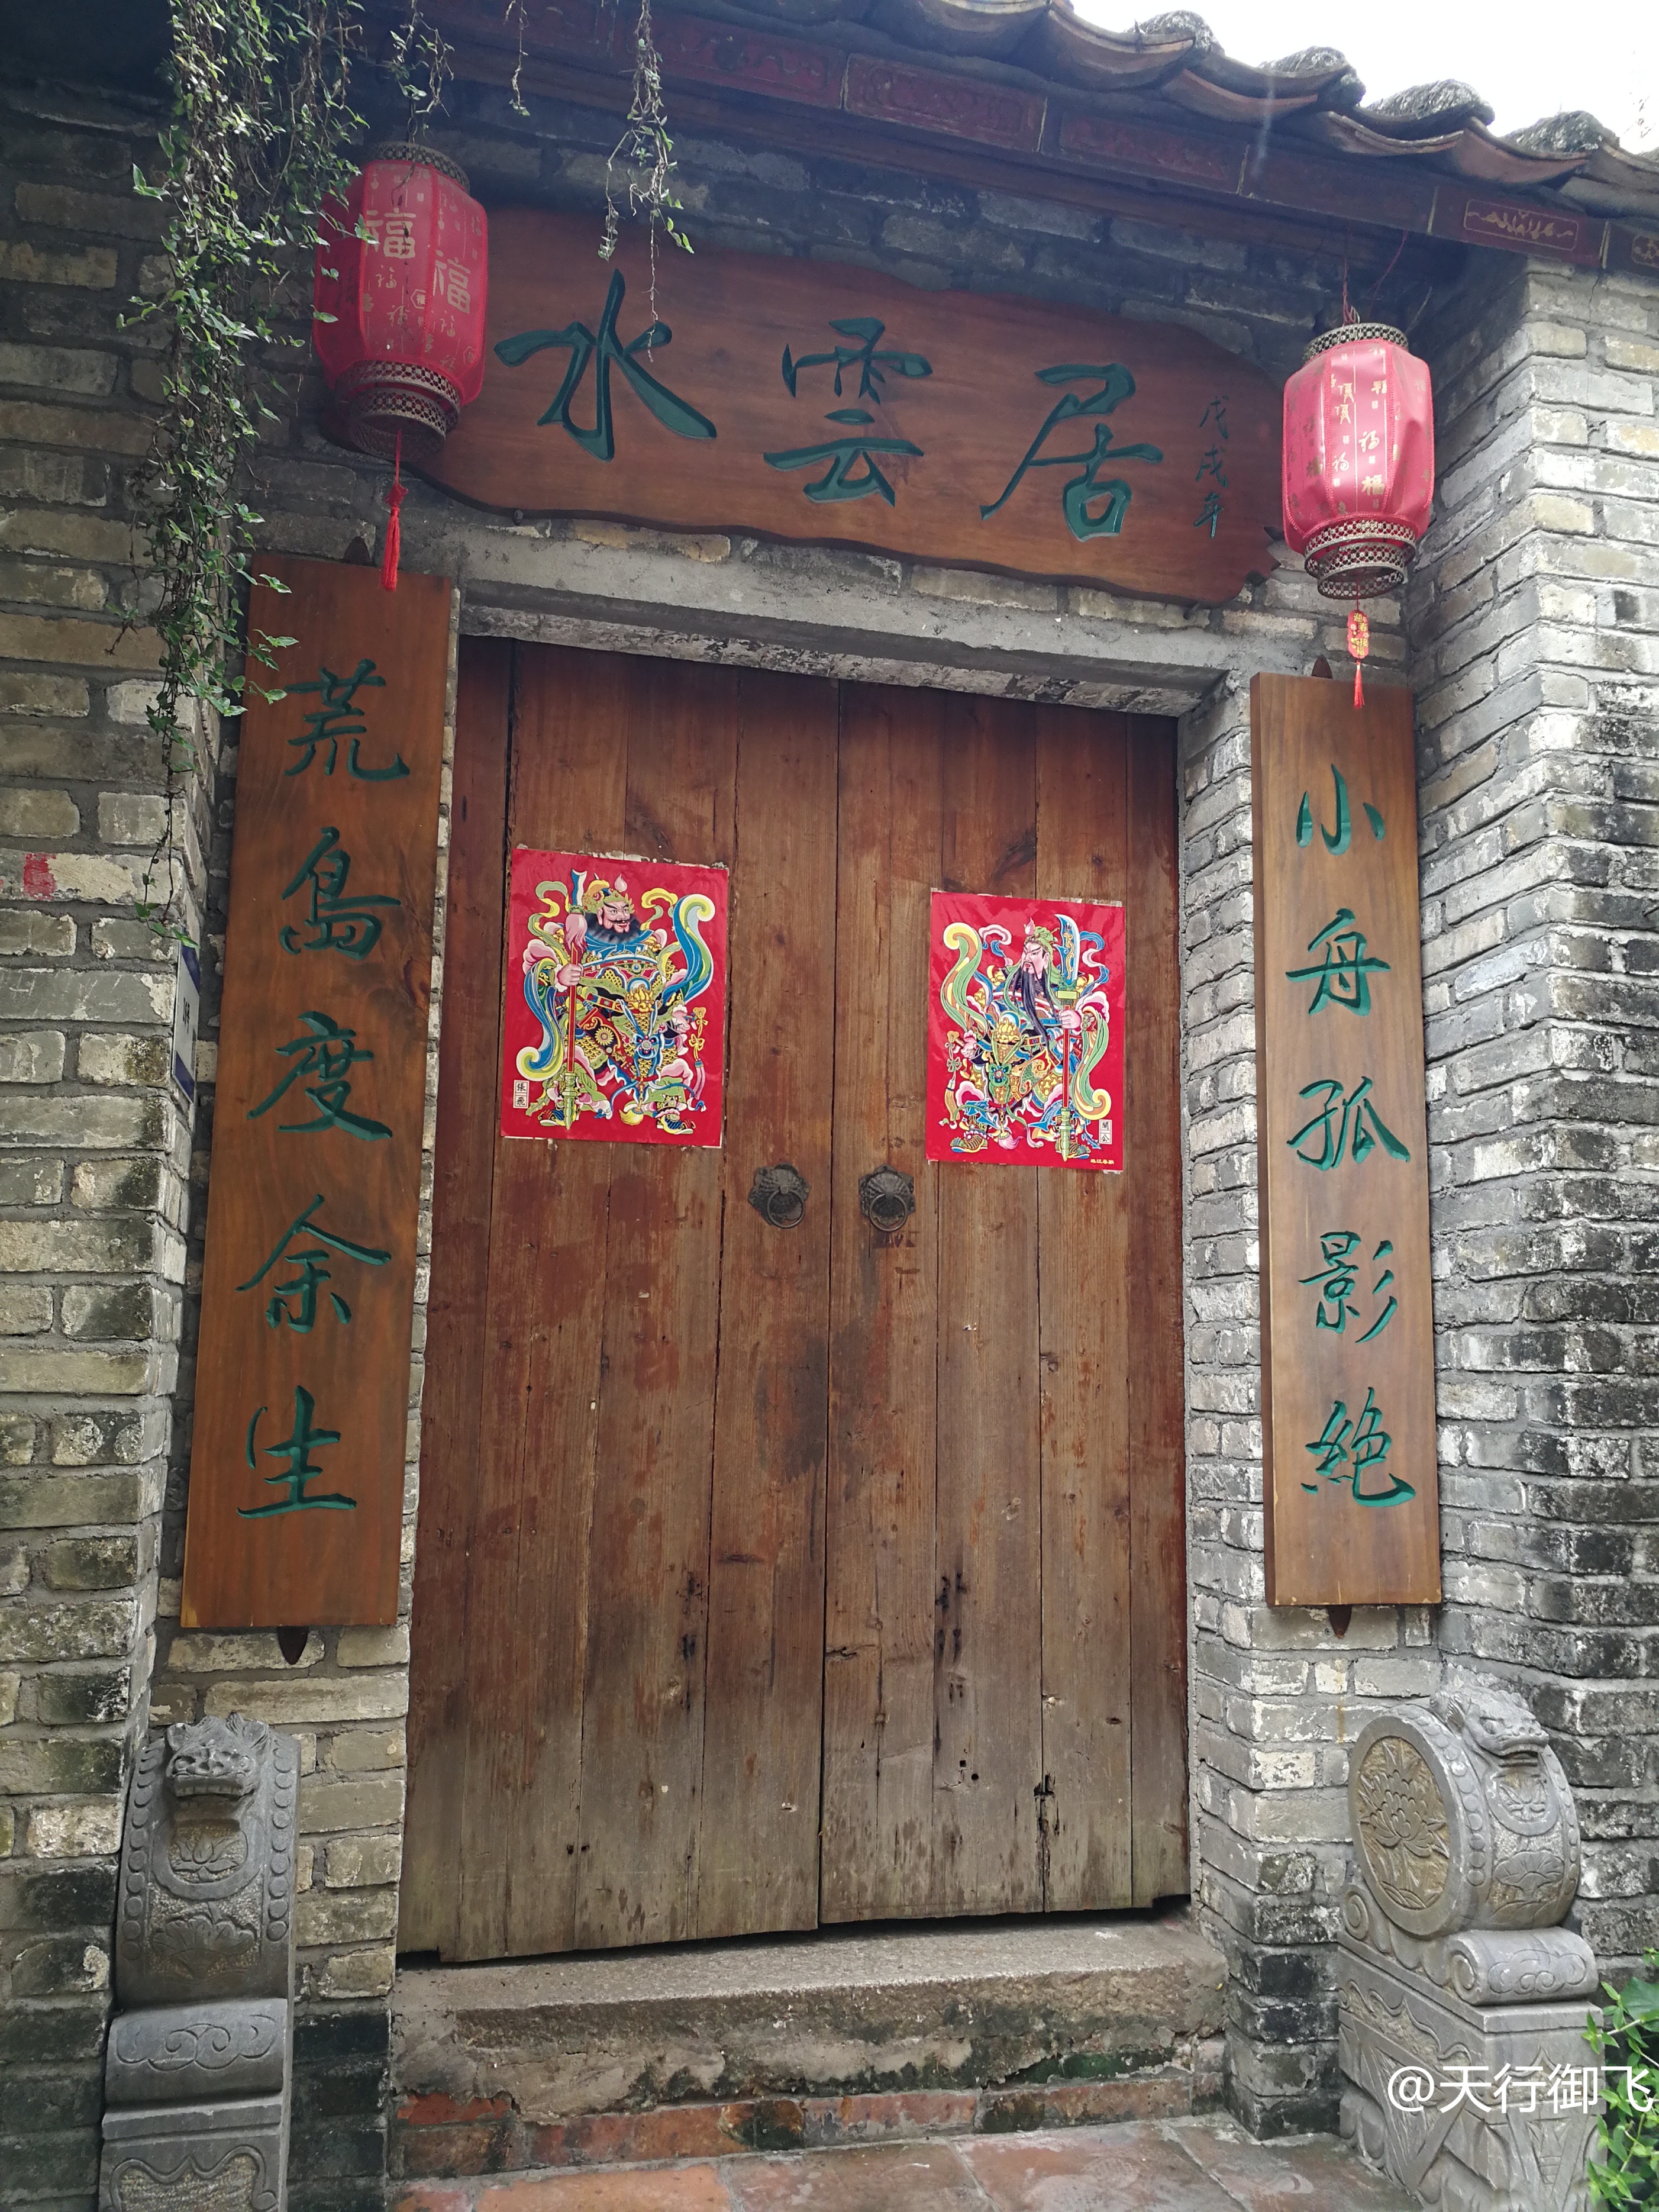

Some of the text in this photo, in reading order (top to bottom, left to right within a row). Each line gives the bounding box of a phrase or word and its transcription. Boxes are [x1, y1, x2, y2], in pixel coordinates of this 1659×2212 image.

[366, 207, 417, 259] 福
[434, 249, 471, 314] 福
[493, 268, 1164, 543] 水雲居
[1361, 474, 1385, 496] 福
